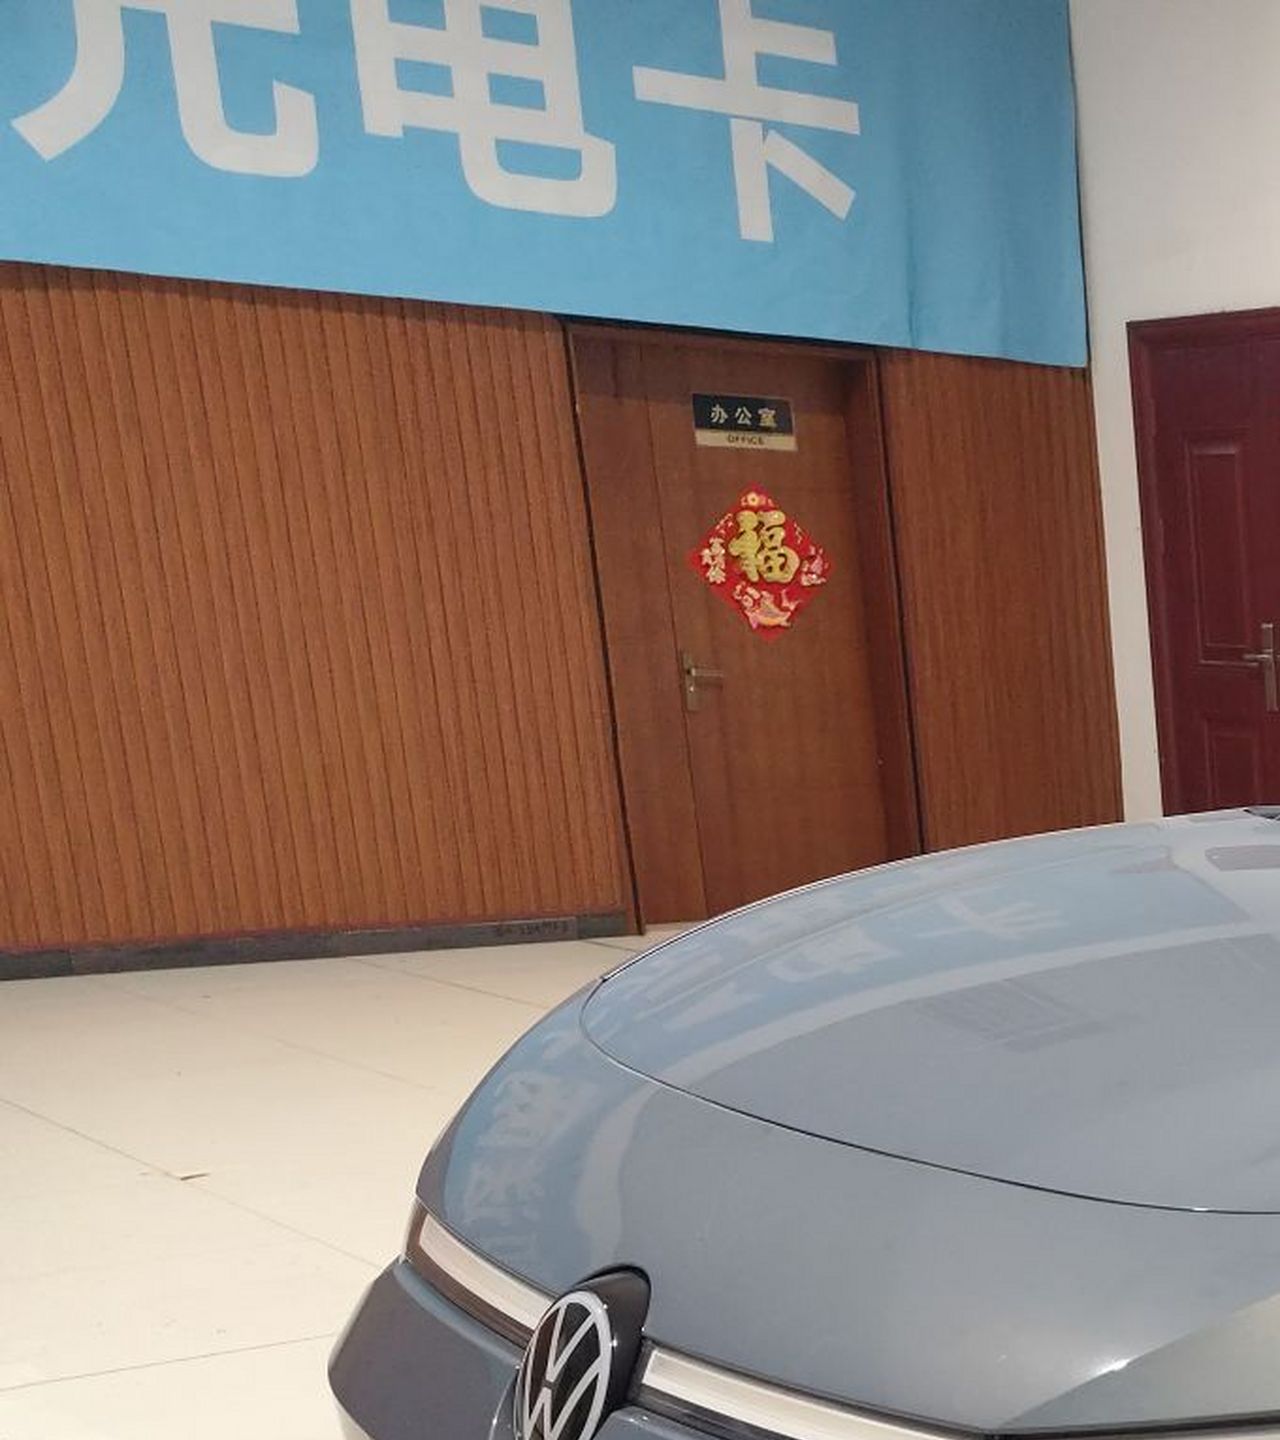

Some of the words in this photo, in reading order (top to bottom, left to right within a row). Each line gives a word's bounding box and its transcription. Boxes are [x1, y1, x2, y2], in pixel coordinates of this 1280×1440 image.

[710, 404, 777, 428] 办公室
[727, 434, 764, 445] OFFICE
[728, 510, 800, 583] 福
